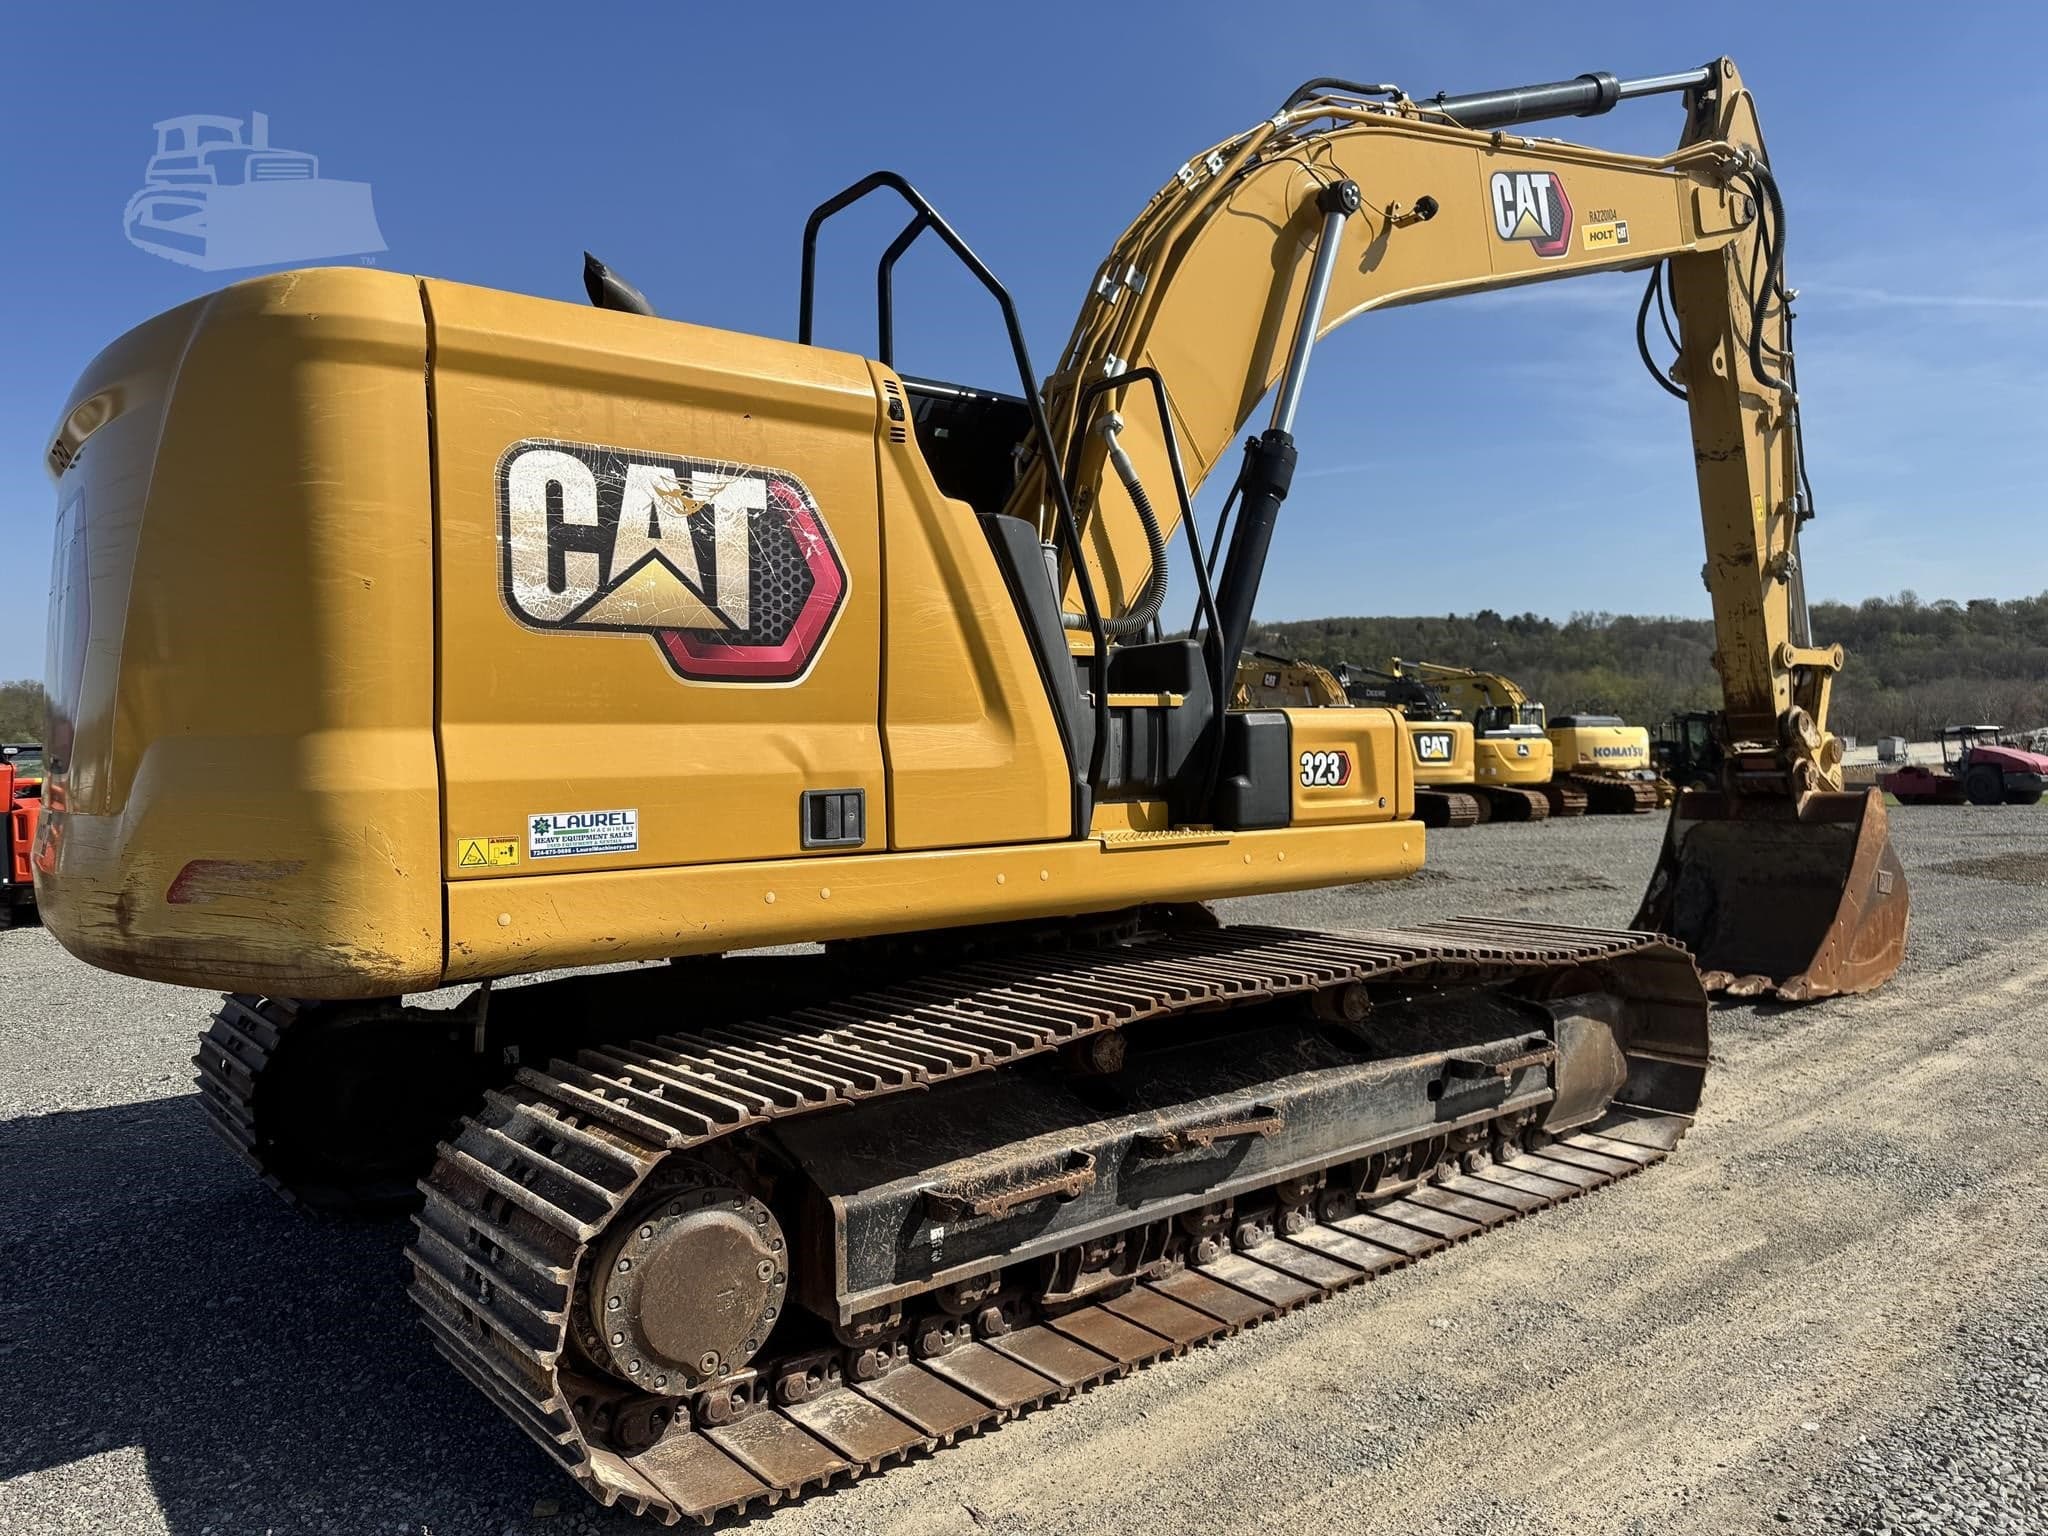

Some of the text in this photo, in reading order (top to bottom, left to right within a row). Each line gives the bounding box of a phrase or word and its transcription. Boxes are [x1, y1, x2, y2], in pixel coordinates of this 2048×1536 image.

[1492, 173, 1552, 239] CAT
[1589, 229, 1614, 242] HOLT
[508, 449, 768, 631] CAT
[1419, 736, 1449, 758] CAT
[1593, 746, 1643, 758] KOMATSU
[1301, 752, 1340, 786] 323
[553, 812, 635, 830] LAUREL
[590, 825, 635, 833] MACHINERY
[534, 831, 633, 845] HEAVY EQUIPMENT SALES
